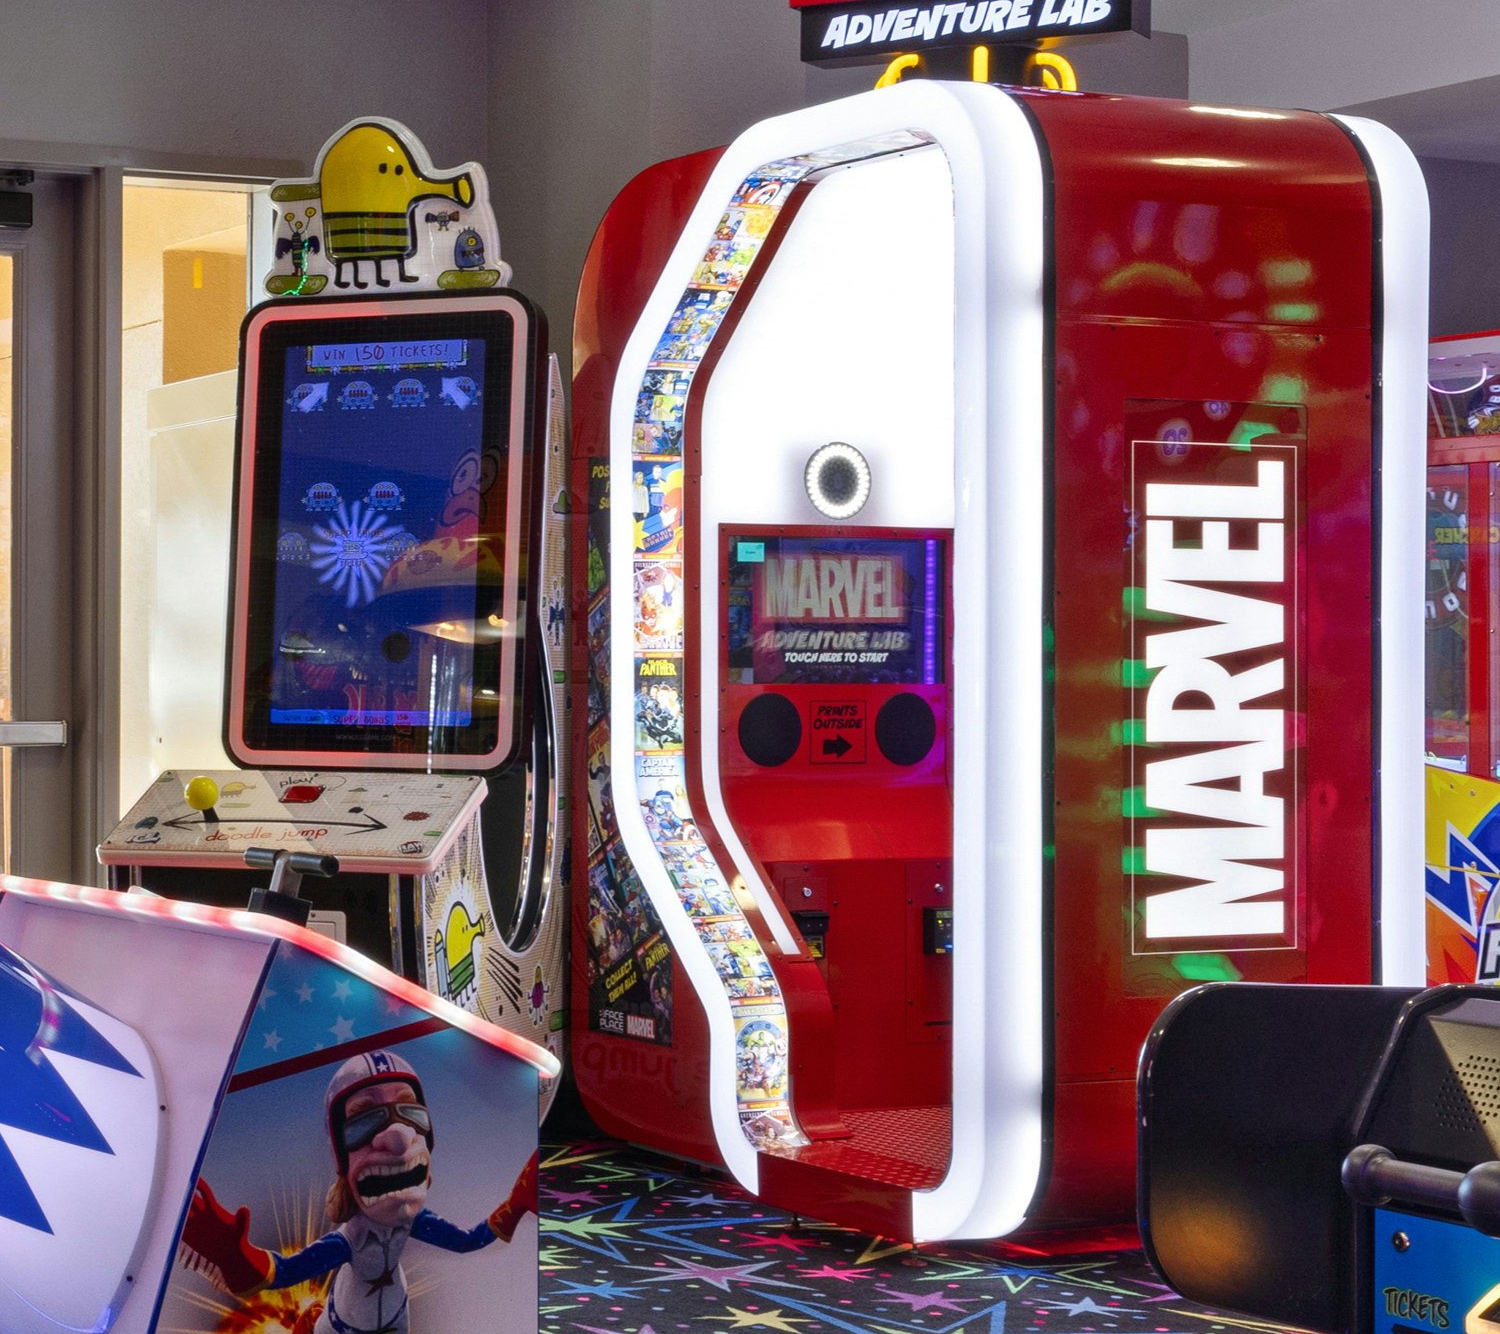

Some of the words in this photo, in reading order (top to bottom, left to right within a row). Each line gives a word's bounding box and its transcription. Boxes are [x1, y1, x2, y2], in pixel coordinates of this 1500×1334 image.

[323, 349, 346, 361] WIN
[355, 344, 385, 362] 150
[391, 343, 449, 359] TICKETS!
[764, 557, 900, 618] MARVEL
[761, 630, 867, 651] ADVENTURE
[870, 631, 909, 651] LAB
[784, 652, 817, 663] TOUCH
[818, 652, 842, 663] HERE
[844, 652, 858, 663] TO
[859, 652, 889, 663] START
[817, 704, 859, 717] PRINTS
[1146, 460, 1287, 941] MARVEL
[812, 718, 864, 730] OUTSIDE
[280, 774, 315, 790] play
[205, 826, 273, 843] doodle
[276, 825, 329, 843] jump
[604, 958, 633, 990] COLLECT
[627, 1015, 655, 1039] MARVEL
[1382, 1285, 1451, 1330] TICKETS
